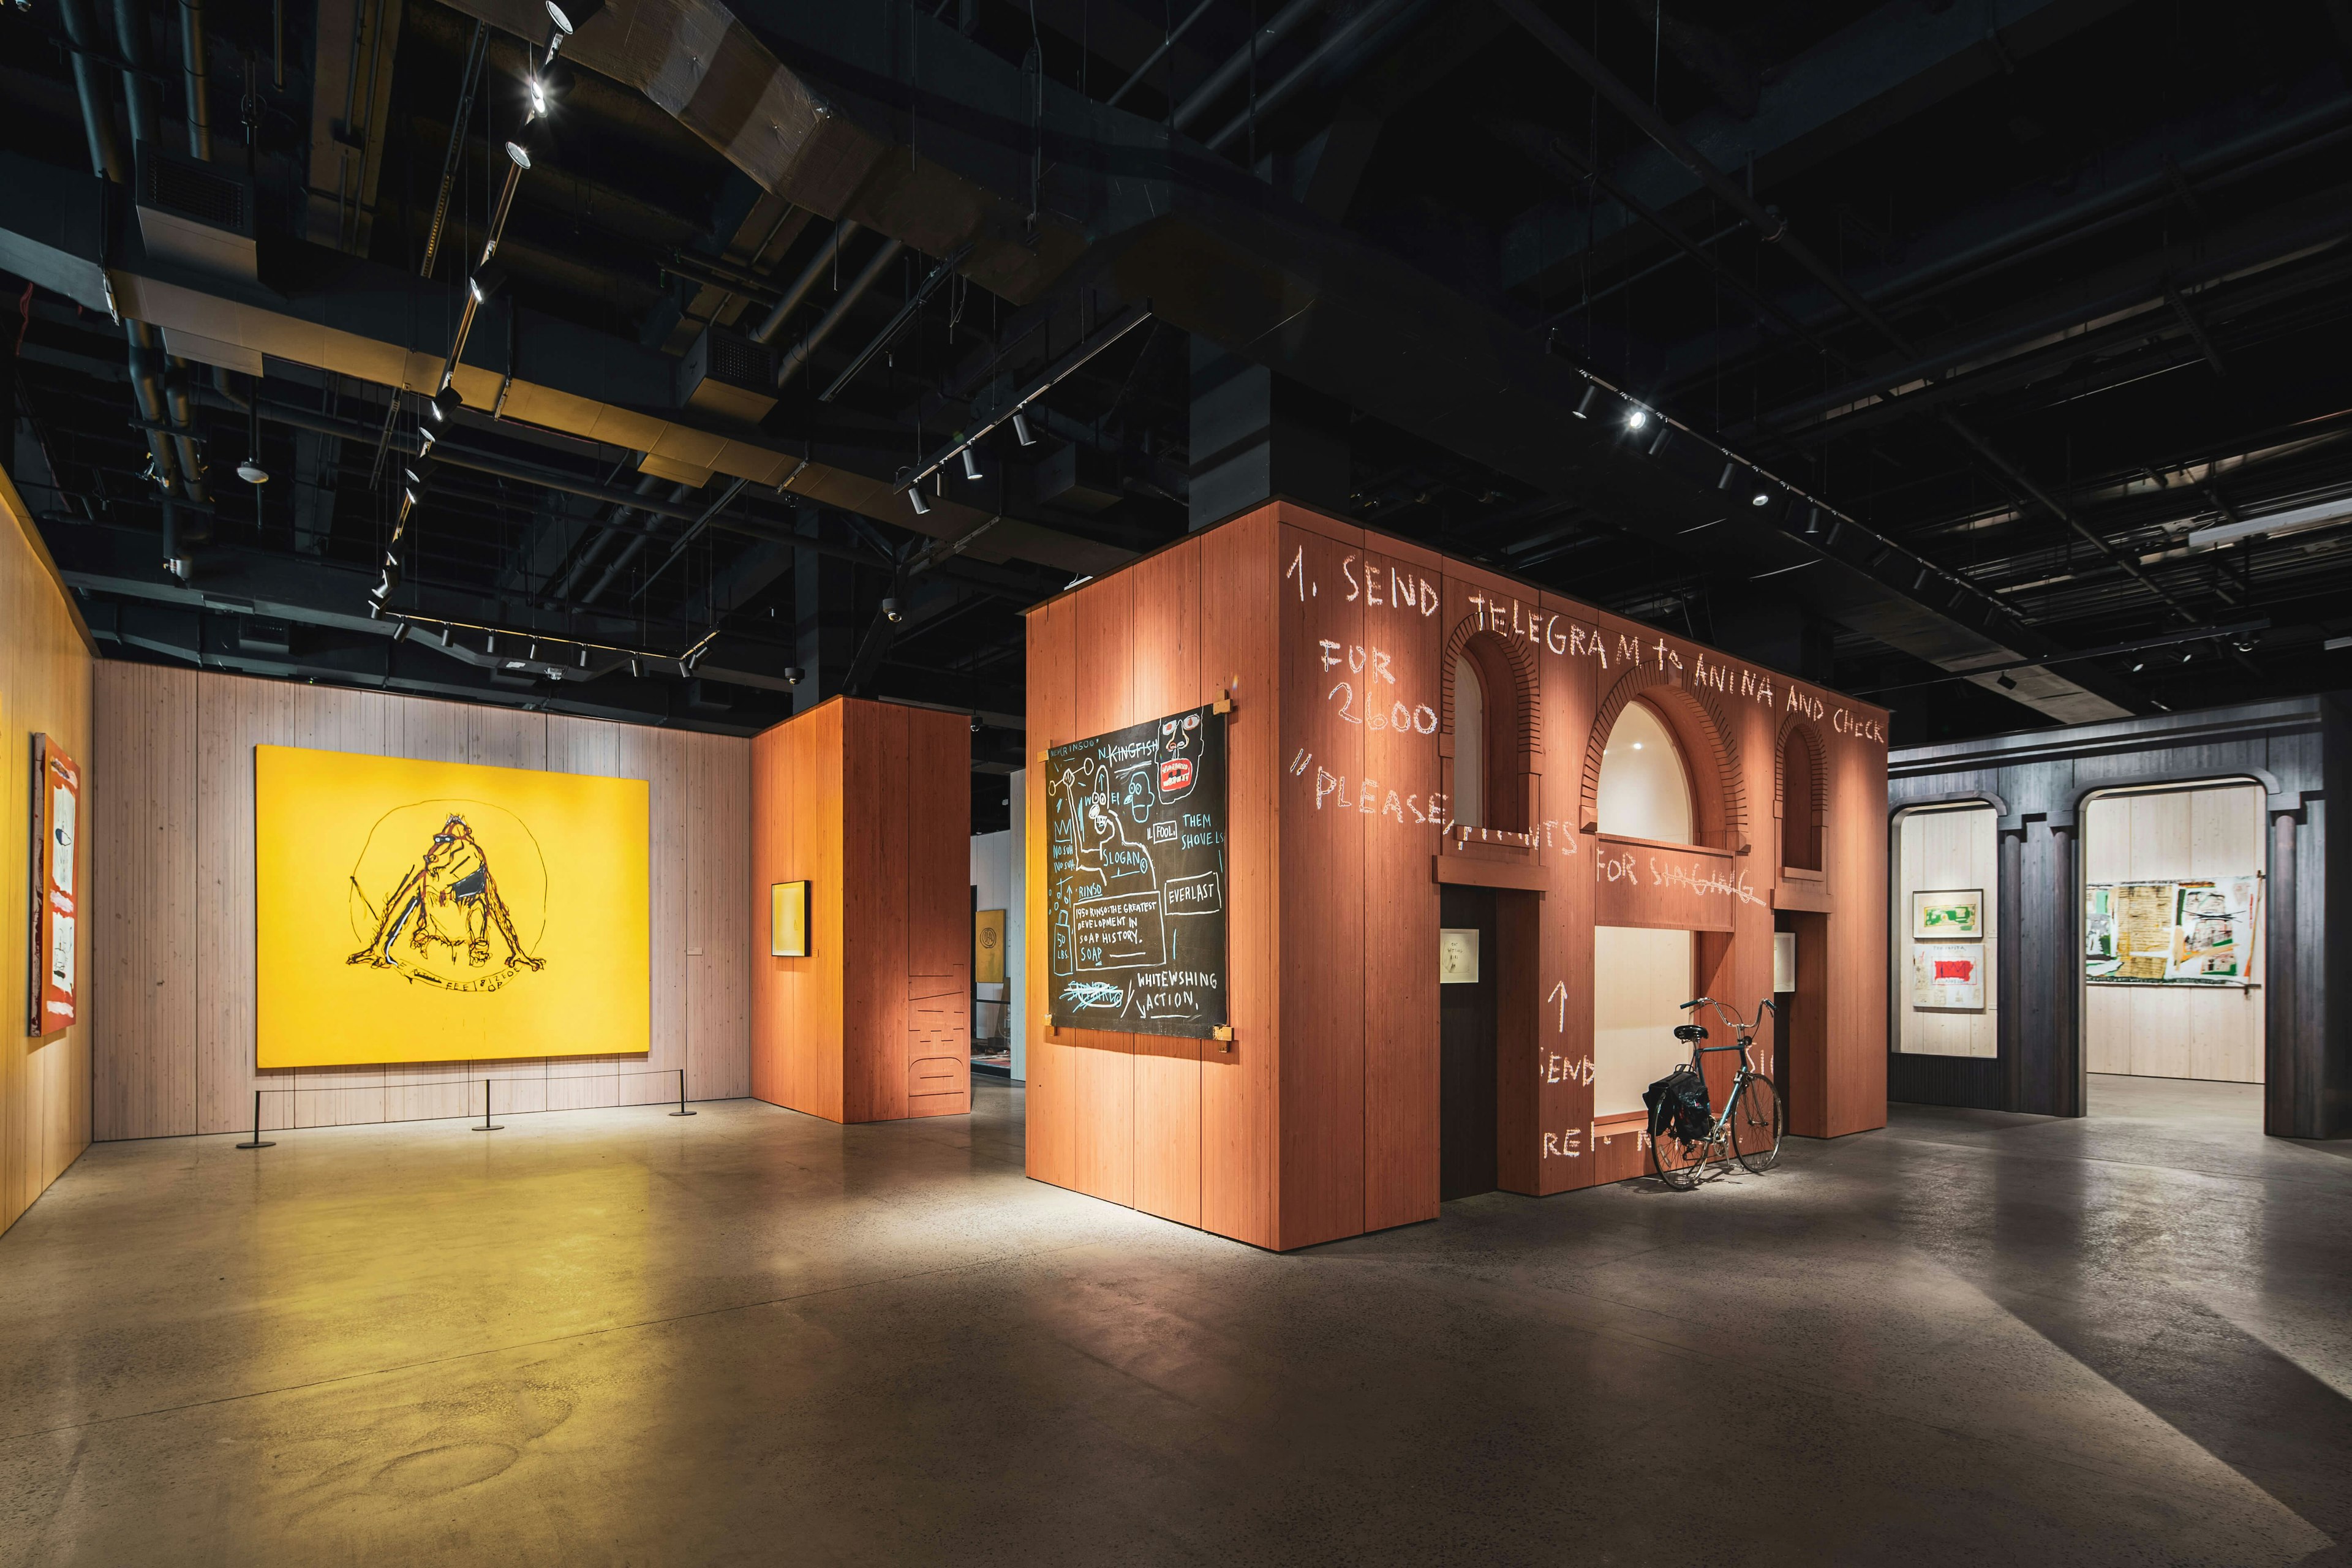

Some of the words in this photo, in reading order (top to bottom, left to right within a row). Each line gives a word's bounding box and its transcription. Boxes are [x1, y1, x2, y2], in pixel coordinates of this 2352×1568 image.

[1286, 545, 1317, 602] 1.
[1342, 553, 1439, 617] SEND
[1694, 652, 1773, 707] ANINA
[1786, 684, 1824, 722] AND
[1328, 682, 1438, 734] 2600
[1107, 738, 1159, 768] KINGFISH
[1182, 813, 1212, 829] THEM
[1181, 831, 1224, 851] SHOVELS
[1052, 844, 1063, 859] NO
[1054, 861, 1063, 874] NO
[1597, 846, 1638, 886] FOR
[1168, 883, 1215, 905] EVERLAST
[1076, 908, 1089, 919] 1950
[1123, 901, 1157, 914] GREATEST
[1077, 916, 1126, 931] DEVELOPMENT
[1129, 917, 1138, 929] IN
[1057, 932, 1066, 948] 50
[1079, 932, 1099, 944] SOAP
[1080, 946, 1102, 962] SOAP
[1137, 970, 1218, 990] WHITEWSHING
